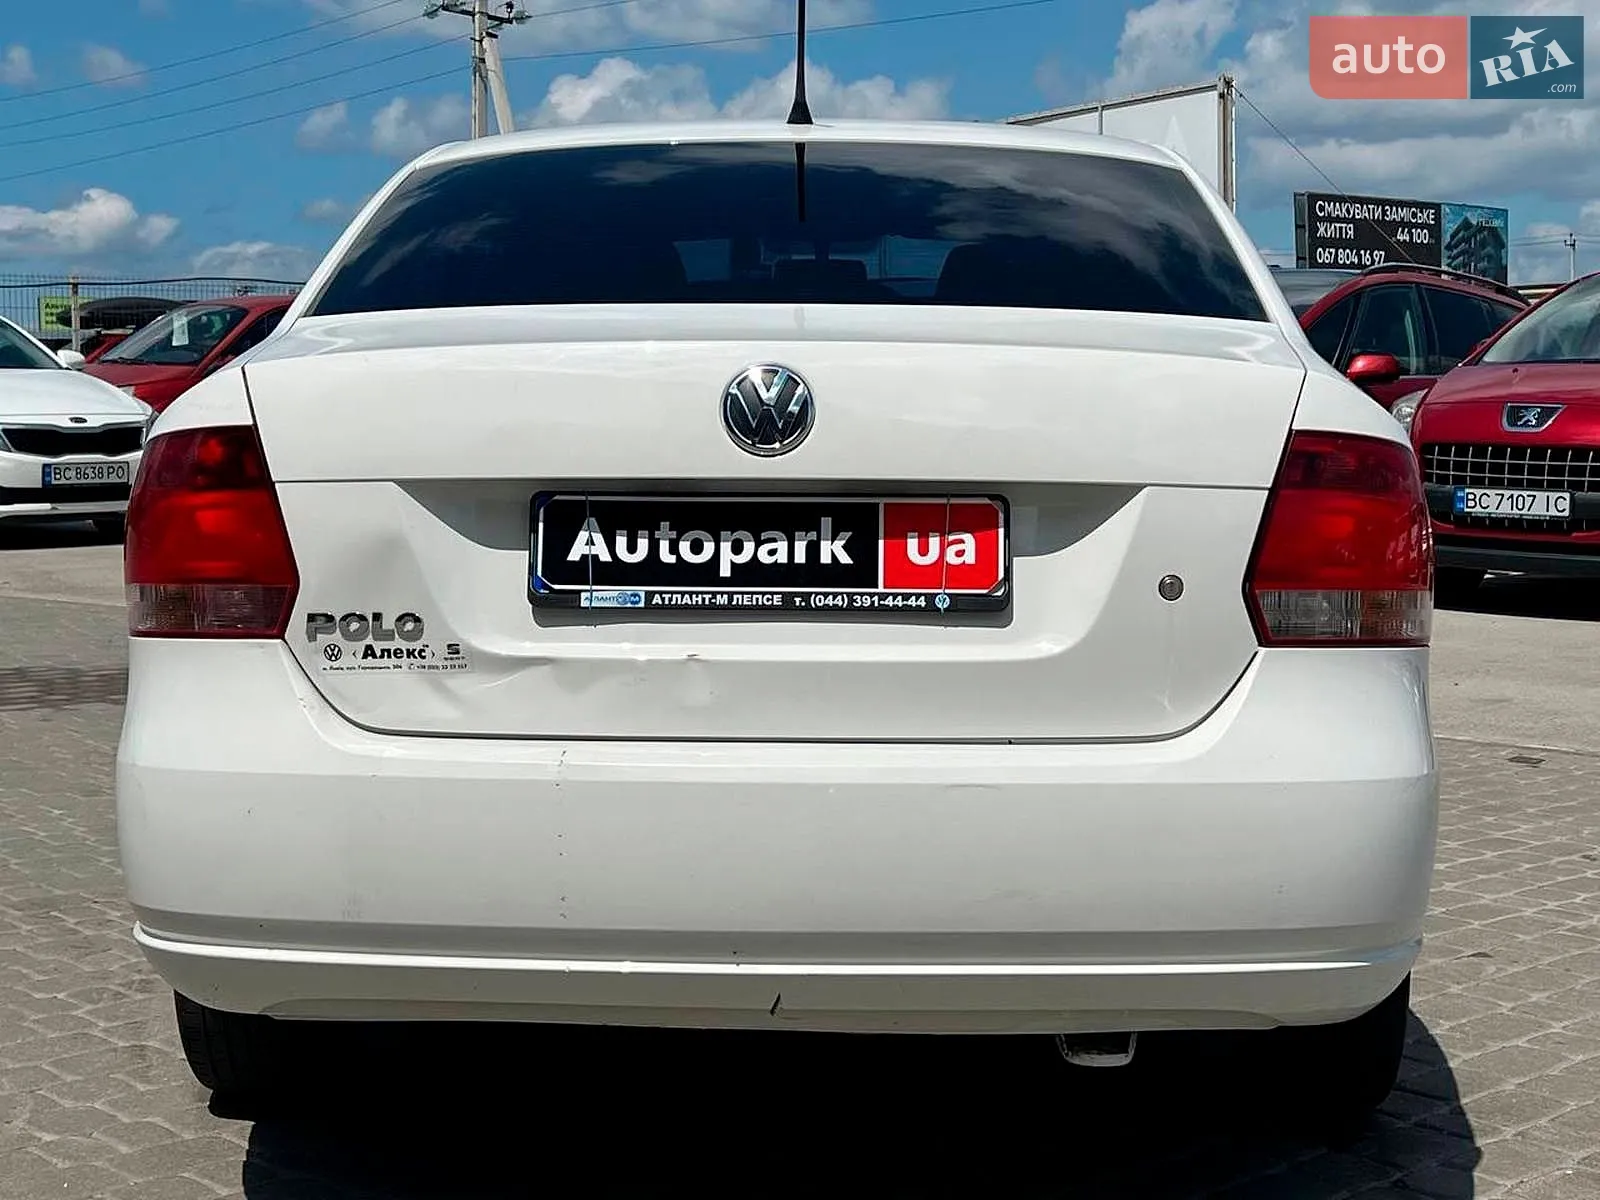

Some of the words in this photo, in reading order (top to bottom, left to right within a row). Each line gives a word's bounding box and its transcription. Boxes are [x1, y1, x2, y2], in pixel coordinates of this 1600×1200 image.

[1315, 200, 1383, 220] СМАКУВАТИ
[1384, 204, 1436, 225] ЗАМІСЬКЕ
[1316, 221, 1355, 240] ЖИТТЯ
[1396, 227, 1410, 243] 44
[1411, 228, 1430, 244] 100
[1316, 248, 1336, 264] 067
[1337, 249, 1359, 264] 804
[1360, 250, 1372, 265] 16
[1373, 250, 1385, 266] 97
[53, 466, 72, 481] BC
[75, 465, 105, 481] 8638
[107, 465, 125, 479] PO
[1465, 491, 1491, 510] BC
[1495, 493, 1537, 512] 7107
[1546, 495, 1567, 514] IC
[566, 516, 855, 578] Autopark
[905, 531, 978, 566] ua
[651, 594, 728, 606] АТЛАНТ-М
[731, 594, 783, 606] ЛЕПСЕ
[794, 597, 806, 607] т.
[810, 593, 849, 608] (044)
[852, 594, 927, 608] 391-44-44
[305, 611, 425, 643] POLO
